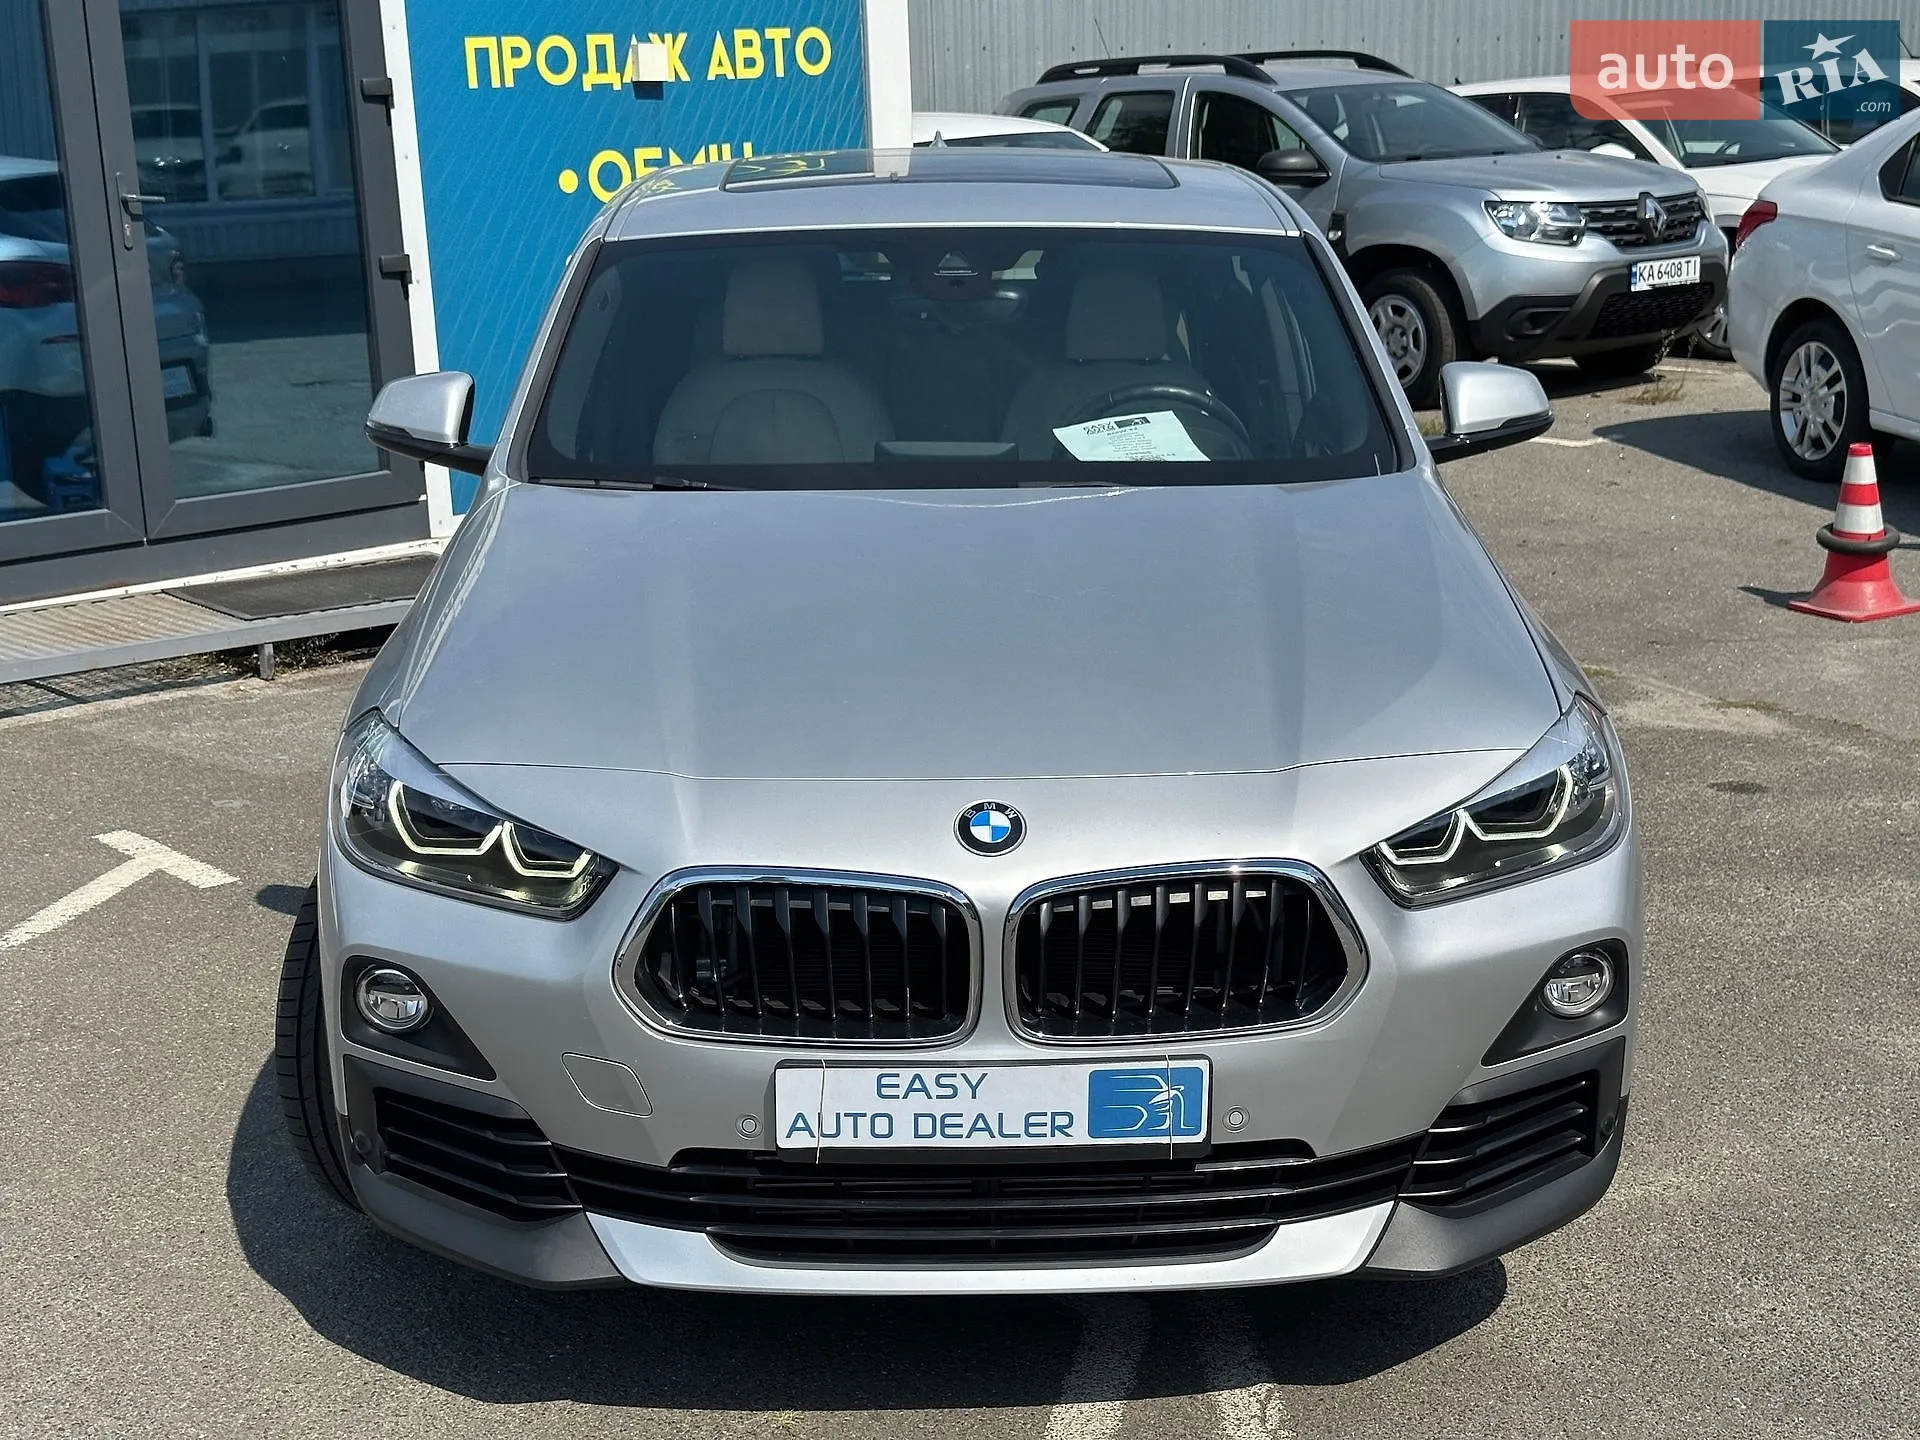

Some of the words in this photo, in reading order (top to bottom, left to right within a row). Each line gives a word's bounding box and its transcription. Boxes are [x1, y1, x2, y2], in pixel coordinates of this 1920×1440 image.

[706, 26, 832, 80] АВТО
[1638, 264, 1655, 283] KA
[1656, 261, 1682, 280] 6408
[1684, 259, 1697, 277] TI
[963, 802, 1018, 819] BMW
[876, 1072, 989, 1099] EASY
[785, 1112, 894, 1139] AUTO
[913, 1111, 1074, 1138] DEALER
